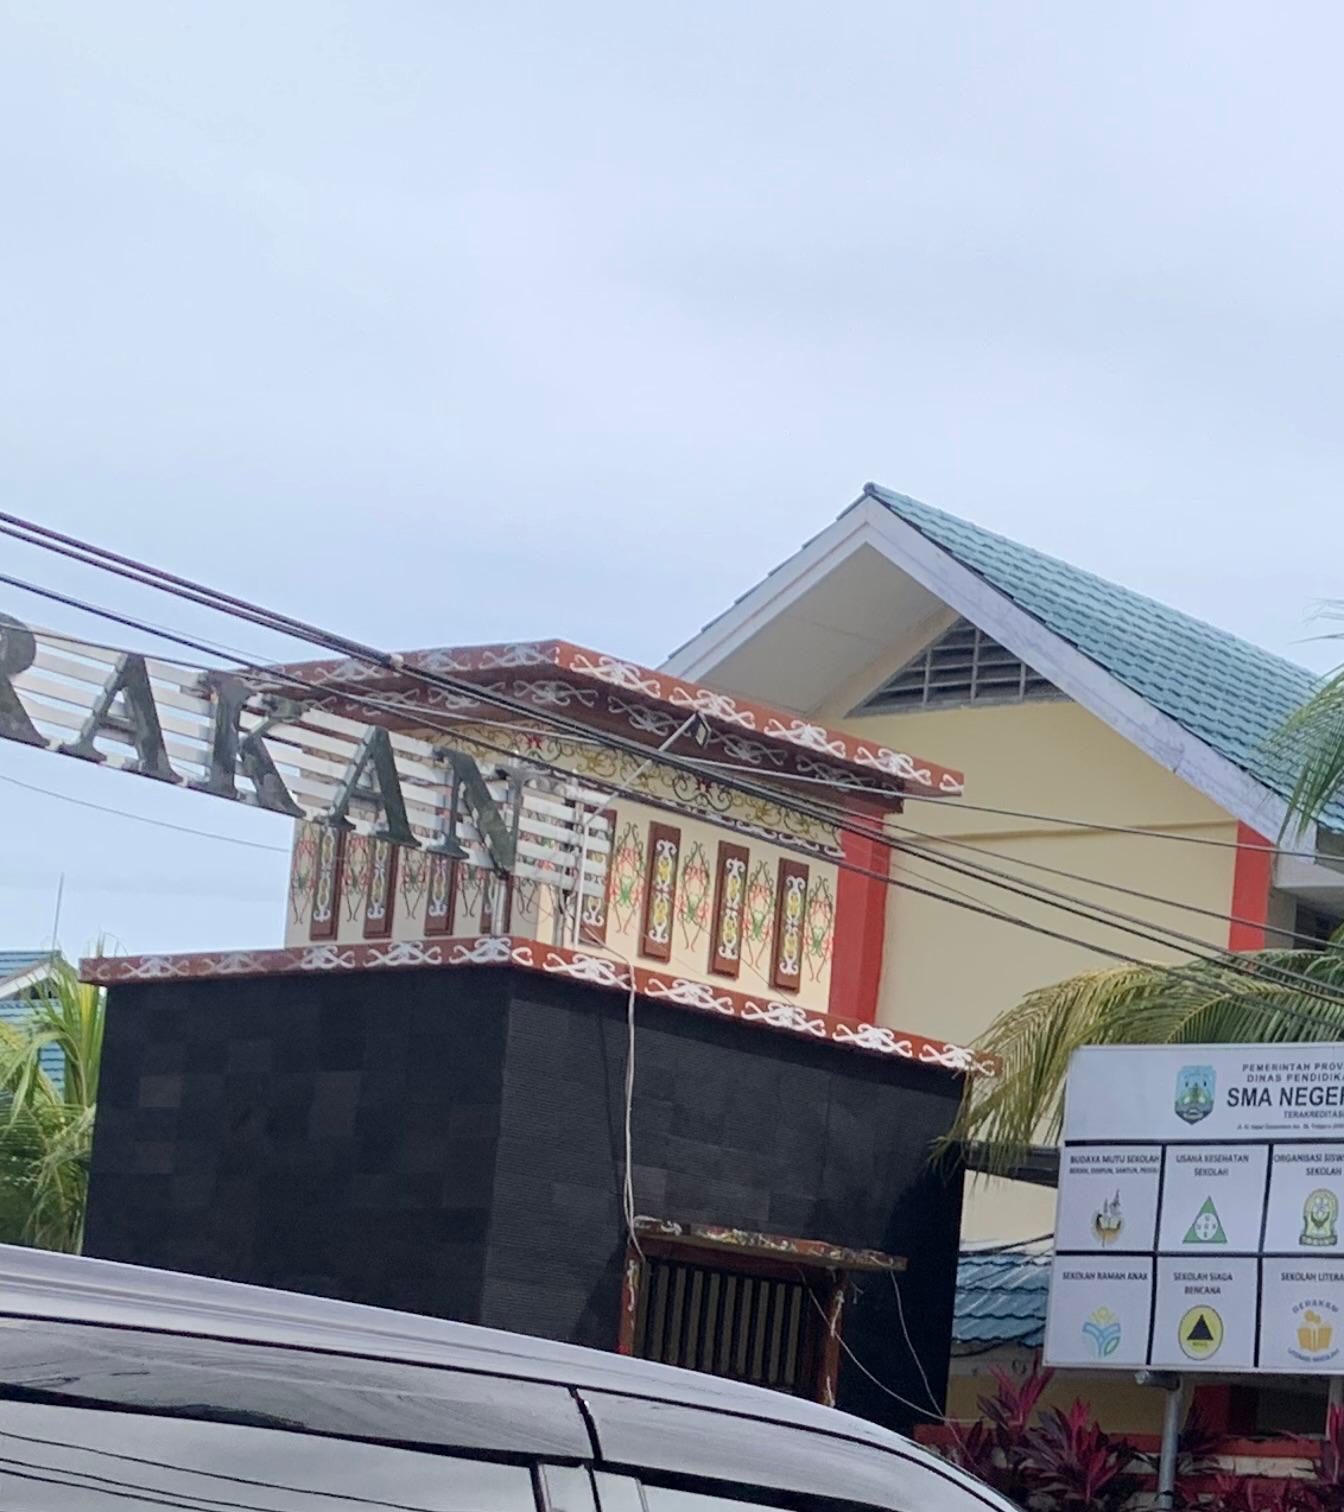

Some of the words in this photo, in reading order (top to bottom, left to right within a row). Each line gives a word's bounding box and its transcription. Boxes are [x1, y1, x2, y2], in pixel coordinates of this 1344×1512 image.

[1242, 1063, 1310, 1072] PEMERINTAH
[1246, 1074, 1282, 1082] DINAS
[1226, 1087, 1273, 1108] SMA
[1283, 1110, 1344, 1119] TERAKREDITASI
[1102, 1154, 1126, 1163] MUTU
[1204, 1153, 1249, 1163] KESEHATAN
[1274, 1153, 1323, 1163] ORGANISASI
[1194, 1167, 1229, 1177] SEKOLAH
[1306, 1167, 1342, 1176] SEKOLAH
[1063, 1271, 1096, 1281] SEKOLAH
[1127, 1271, 1148, 1280] ANAK
[1174, 1272, 1208, 1281] SEKOLAH
[1209, 1272, 1233, 1281] SIAGA
[1281, 1272, 1317, 1282] SEKOLAH
[1184, 1286, 1221, 1295] BENCANA
